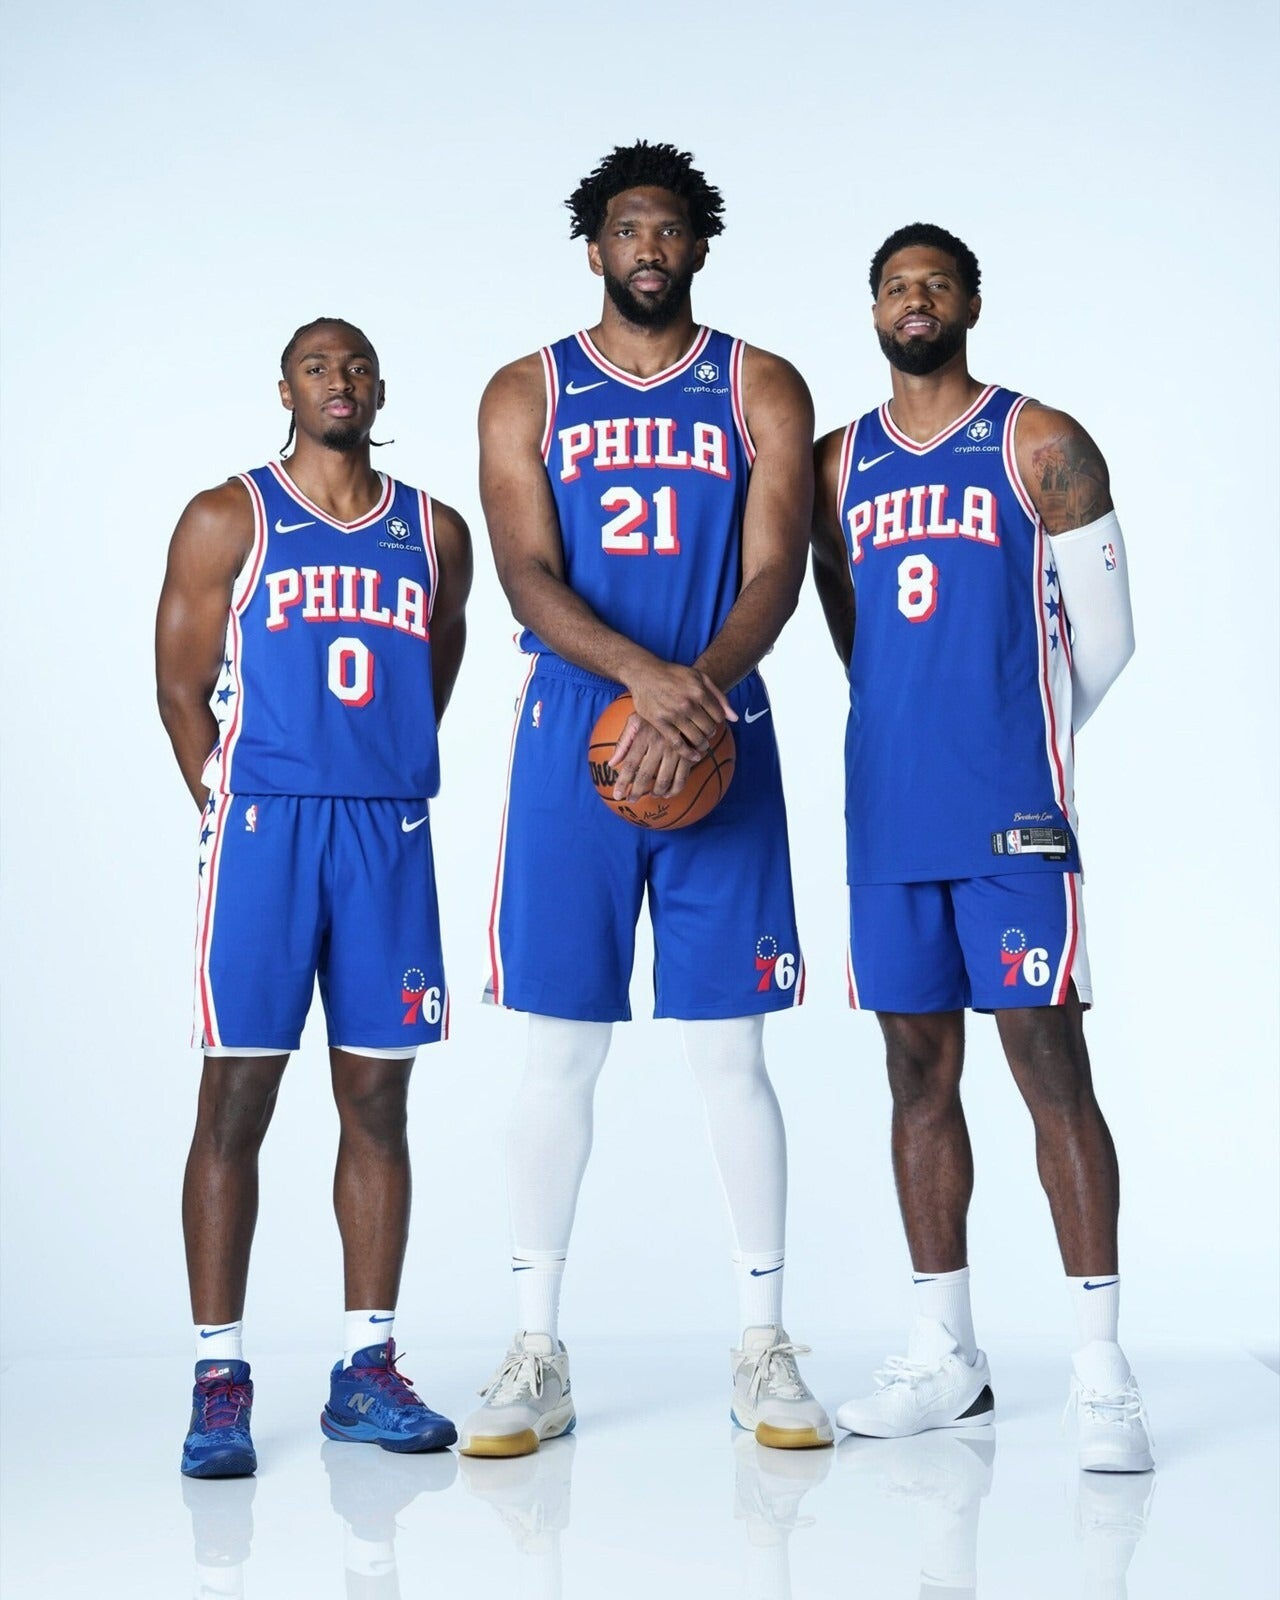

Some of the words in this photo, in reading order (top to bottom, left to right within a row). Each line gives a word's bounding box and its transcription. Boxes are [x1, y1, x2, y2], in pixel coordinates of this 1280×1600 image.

[683, 386, 729, 394] crypto.com
[558, 417, 731, 484] PHILA
[954, 445, 1000, 453] crypto.com
[379, 541, 422, 552] crypto.com
[600, 486, 680, 555] 21
[847, 484, 1000, 565] PHILA
[265, 565, 430, 643] PHILA
[897, 553, 939, 623] 8
[328, 636, 374, 707] 0
[755, 953, 796, 992] 76
[1001, 947, 1050, 987] 76
[402, 986, 441, 1025] 76
